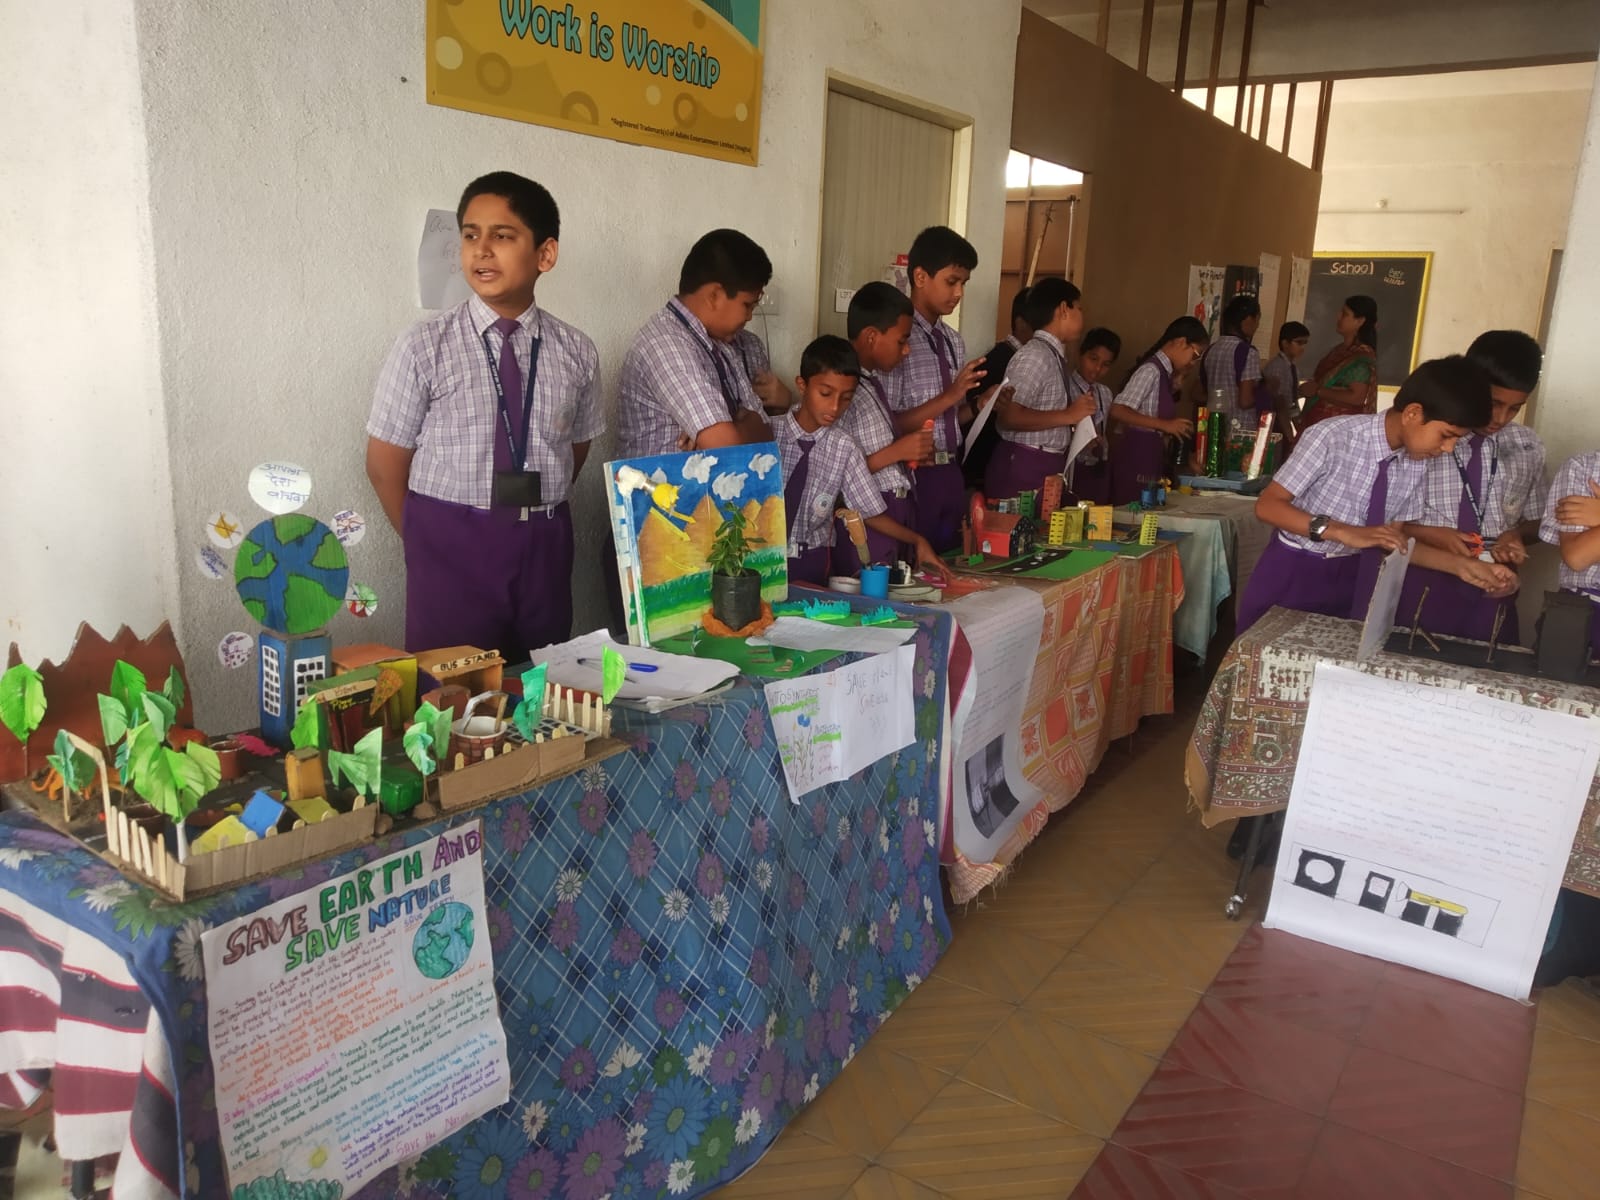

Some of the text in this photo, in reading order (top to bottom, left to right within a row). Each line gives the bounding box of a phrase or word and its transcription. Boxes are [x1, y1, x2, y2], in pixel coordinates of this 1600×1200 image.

[499, 0, 720, 89] Work is Worship
[1330, 260, 1375, 275] School
[440, 651, 496, 672] BUS STAND
[223, 830, 482, 966] SAVE EARTH AND
[285, 874, 451, 972] SAVE NATURE
